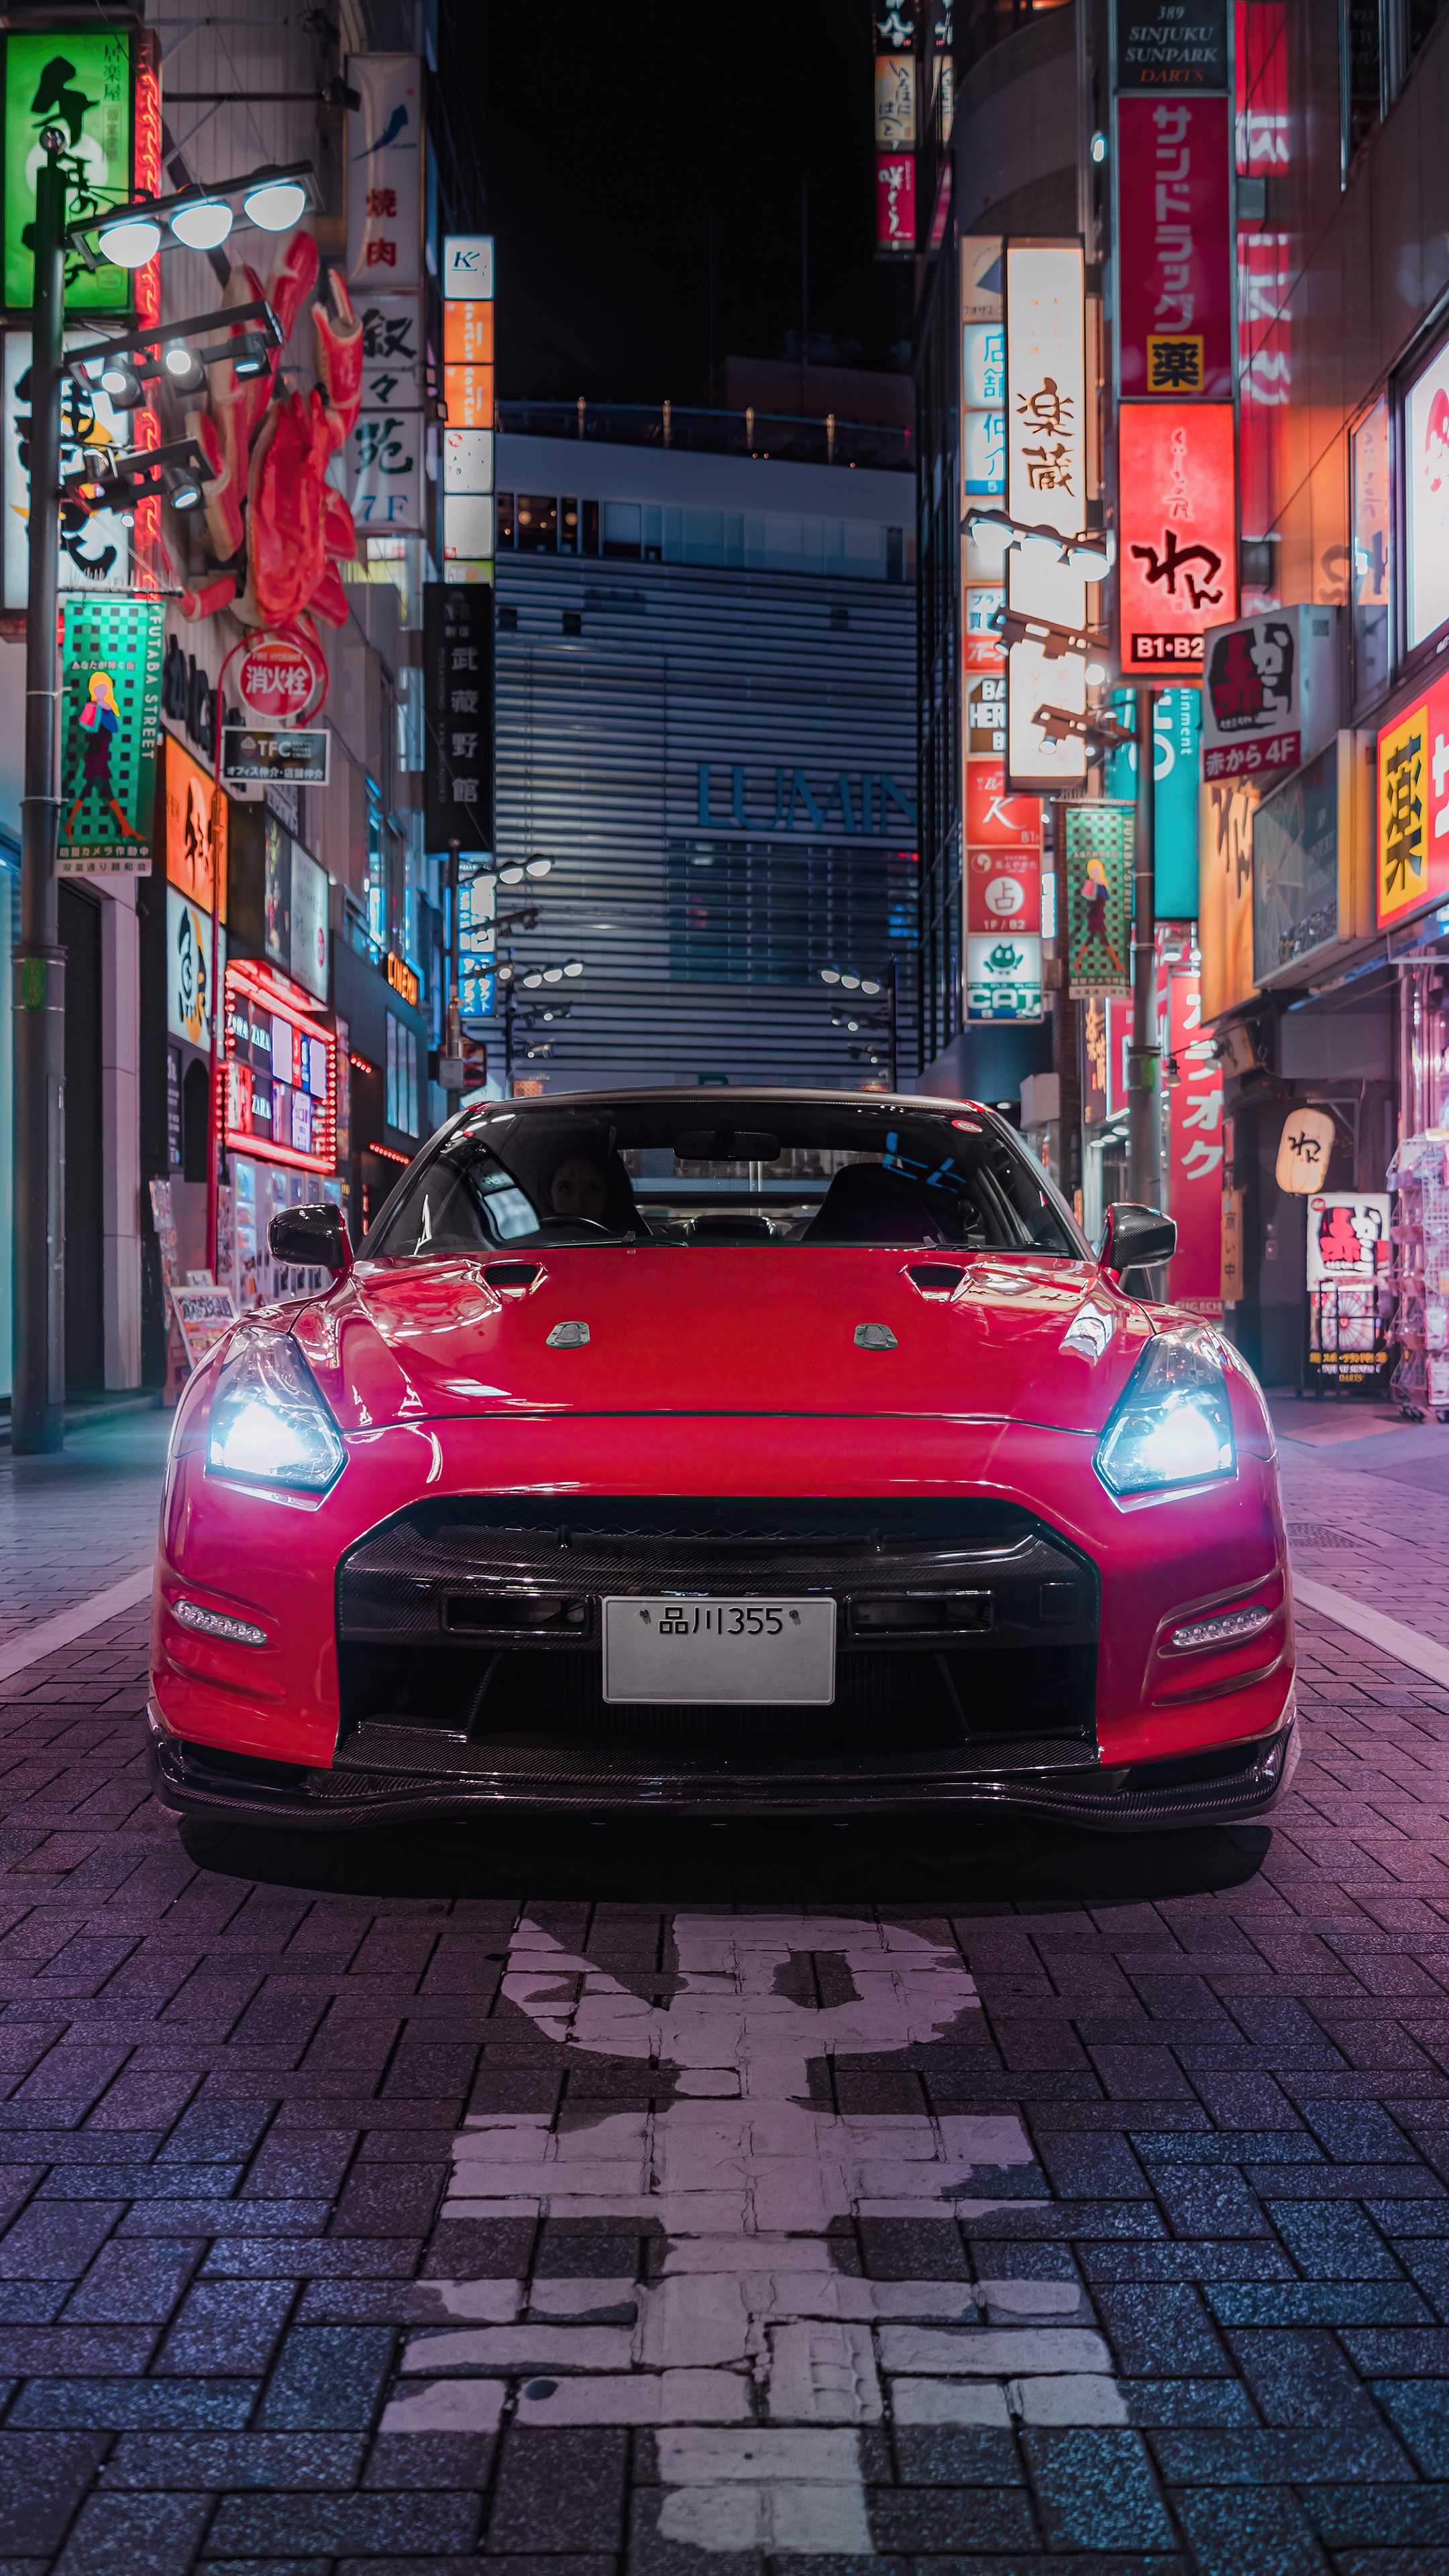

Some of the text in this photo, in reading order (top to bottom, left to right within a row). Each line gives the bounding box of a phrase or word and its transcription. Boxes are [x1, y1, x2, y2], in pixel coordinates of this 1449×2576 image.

[1157, 6, 1185, 20] 389
[1129, 27, 1214, 45] SINJUKU
[1126, 48, 1218, 62] SUNPARK
[1140, 69, 1204, 83] DARTS
[366, 188, 397, 268] 焼肉
[1153, 105, 1194, 332] サンドラッグ
[1152, 342, 1199, 387] 薬
[354, 308, 416, 475] 叙々苑
[1016, 376, 1075, 497] 楽蔵
[360, 495, 408, 523] 7F
[1131, 528, 1223, 610] わん
[252, 651, 302, 662] FIRE HYDRANT
[142, 614, 162, 759] FUTABA STREET
[246, 665, 308, 696] 消火栓
[258, 740, 292, 757] TFC
[1205, 737, 1295, 777] 赤から 4F
[982, 796, 1027, 831] K
[1122, 819, 1134, 920] FUTABA STREET
[1008, 919, 1026, 930] B2
[967, 988, 1042, 1009] CAT
[250, 1024, 272, 1052] ZARA
[251, 1094, 272, 1120] ZARA
[1288, 1131, 1322, 1164] わん
[1224, 1212, 1236, 1281] 商い中
[659, 1607, 784, 1635] 品川355
